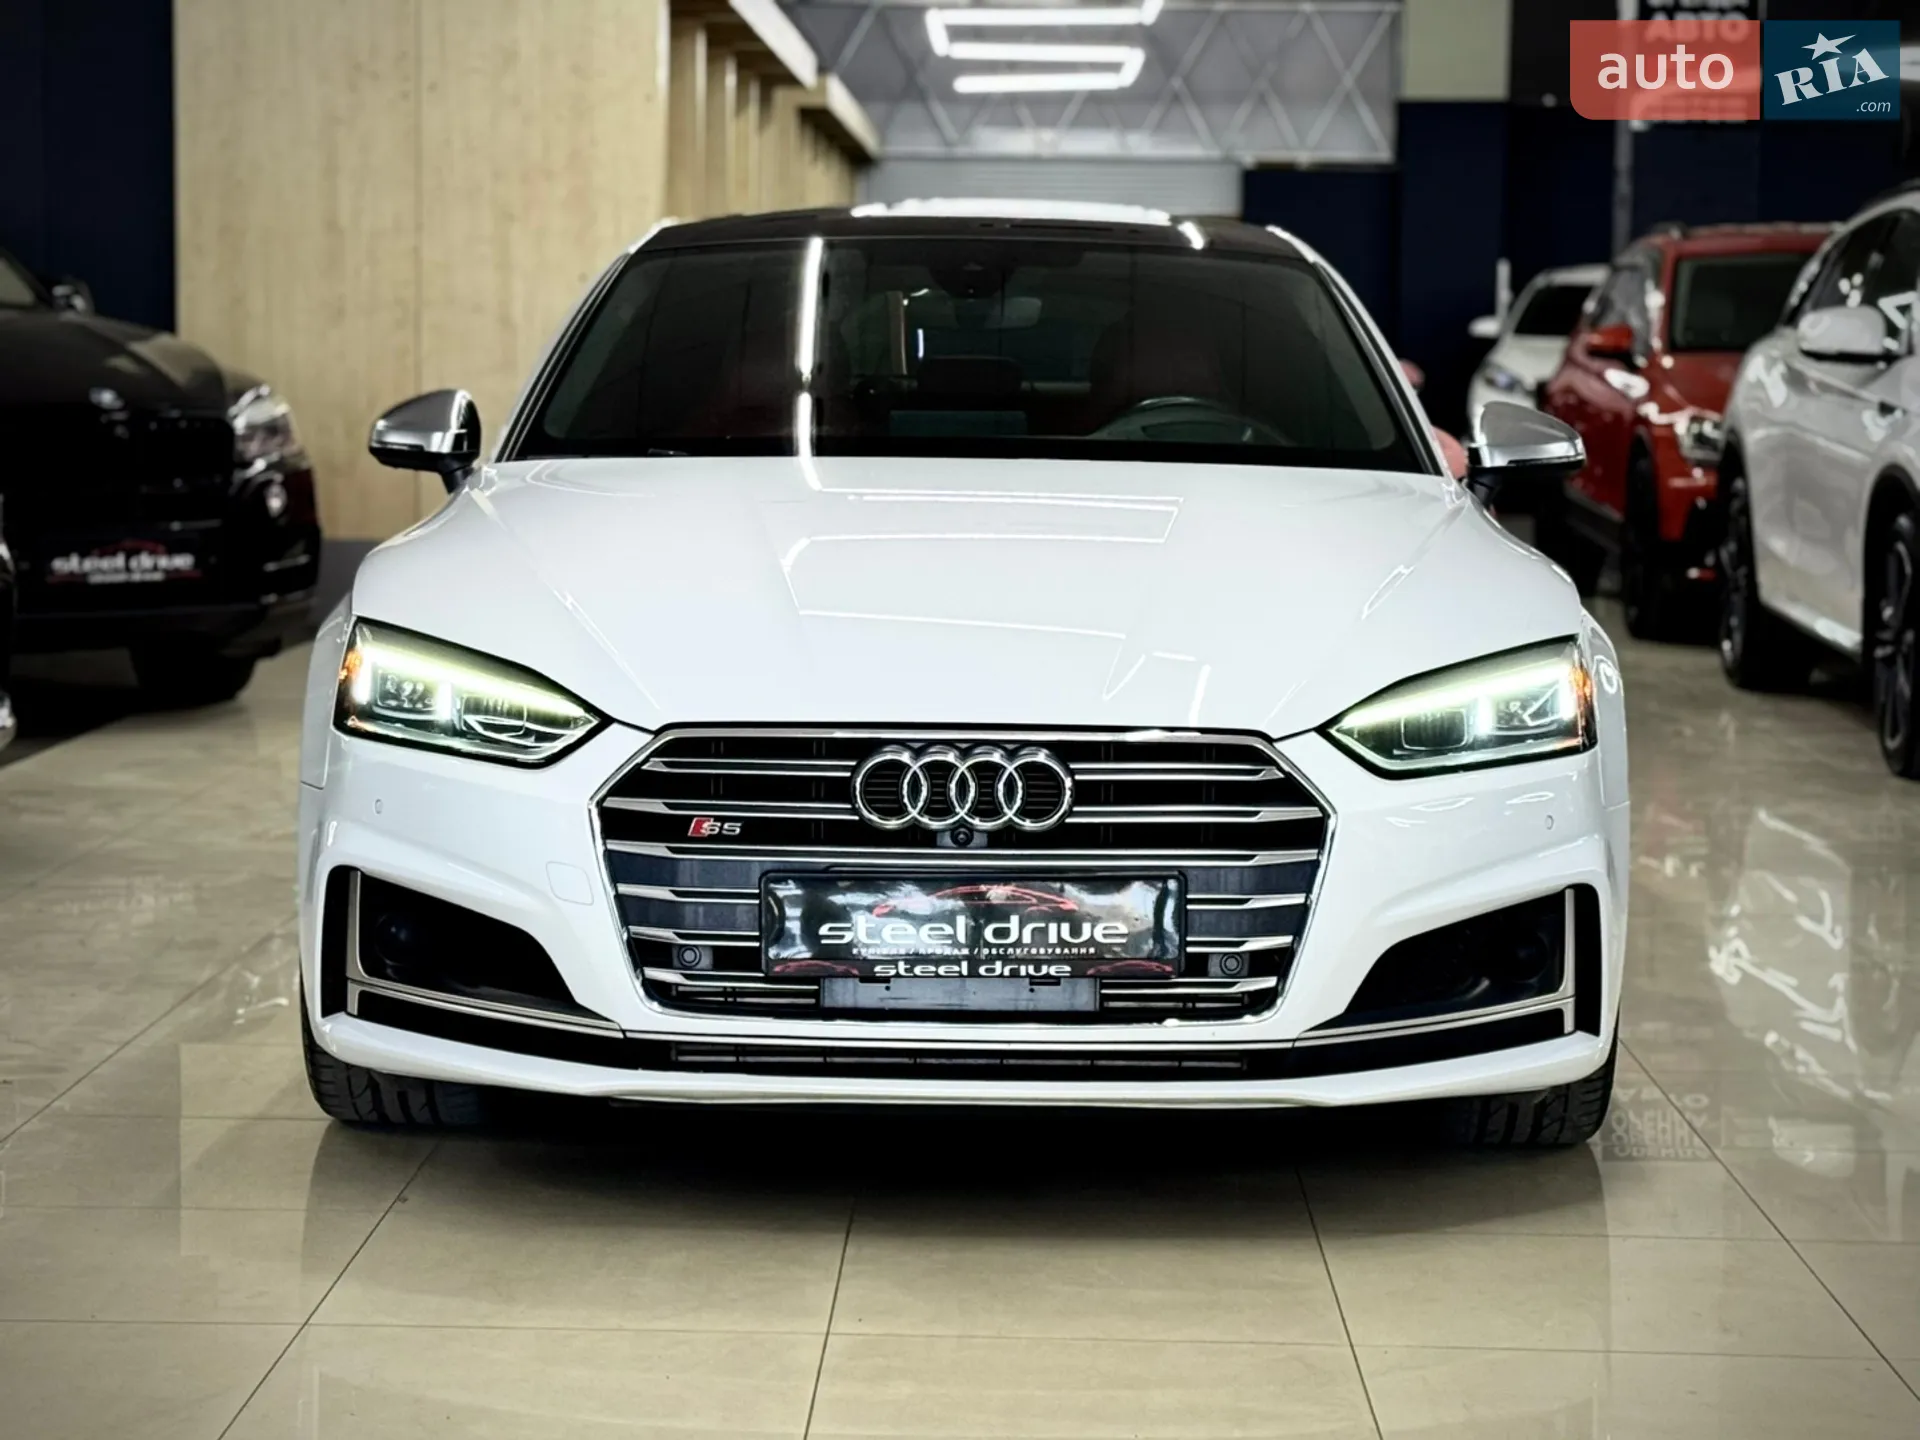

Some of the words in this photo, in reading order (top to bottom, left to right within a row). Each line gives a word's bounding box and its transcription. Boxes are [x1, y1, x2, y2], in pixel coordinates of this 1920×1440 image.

[699, 821, 743, 836] S5
[818, 915, 966, 944] steel
[984, 915, 1129, 944] drive
[873, 961, 968, 976] steel
[978, 961, 1072, 976] drive
